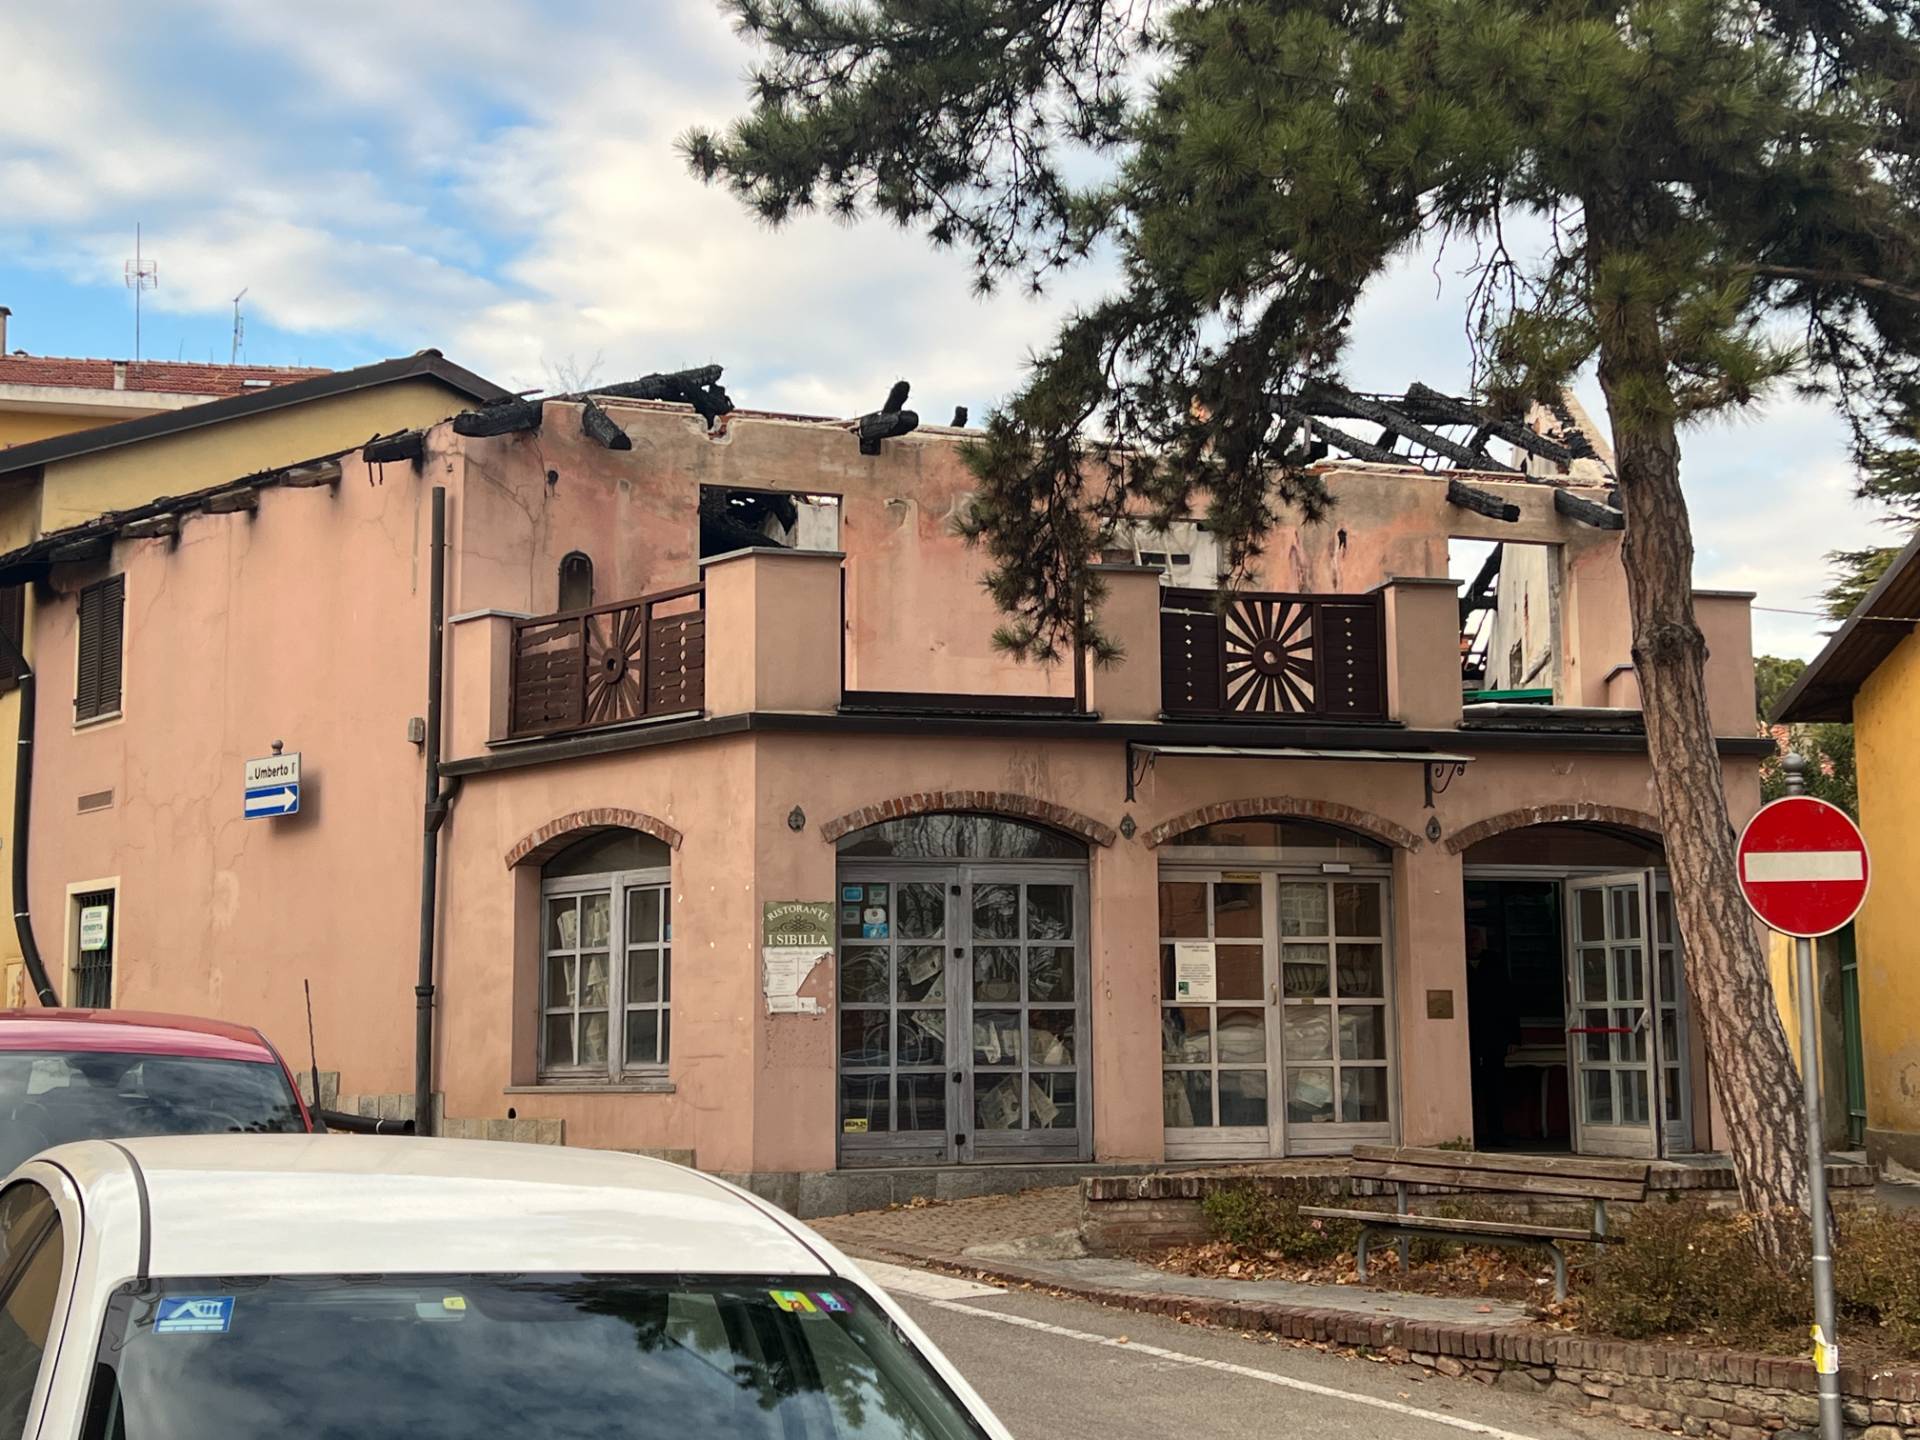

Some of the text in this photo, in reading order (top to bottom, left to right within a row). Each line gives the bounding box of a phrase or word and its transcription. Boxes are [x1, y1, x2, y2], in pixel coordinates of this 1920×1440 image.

[254, 763, 289, 780] Umberto
[767, 904, 830, 922] RISTORANTE
[768, 934, 829, 946] I SIBILLA
